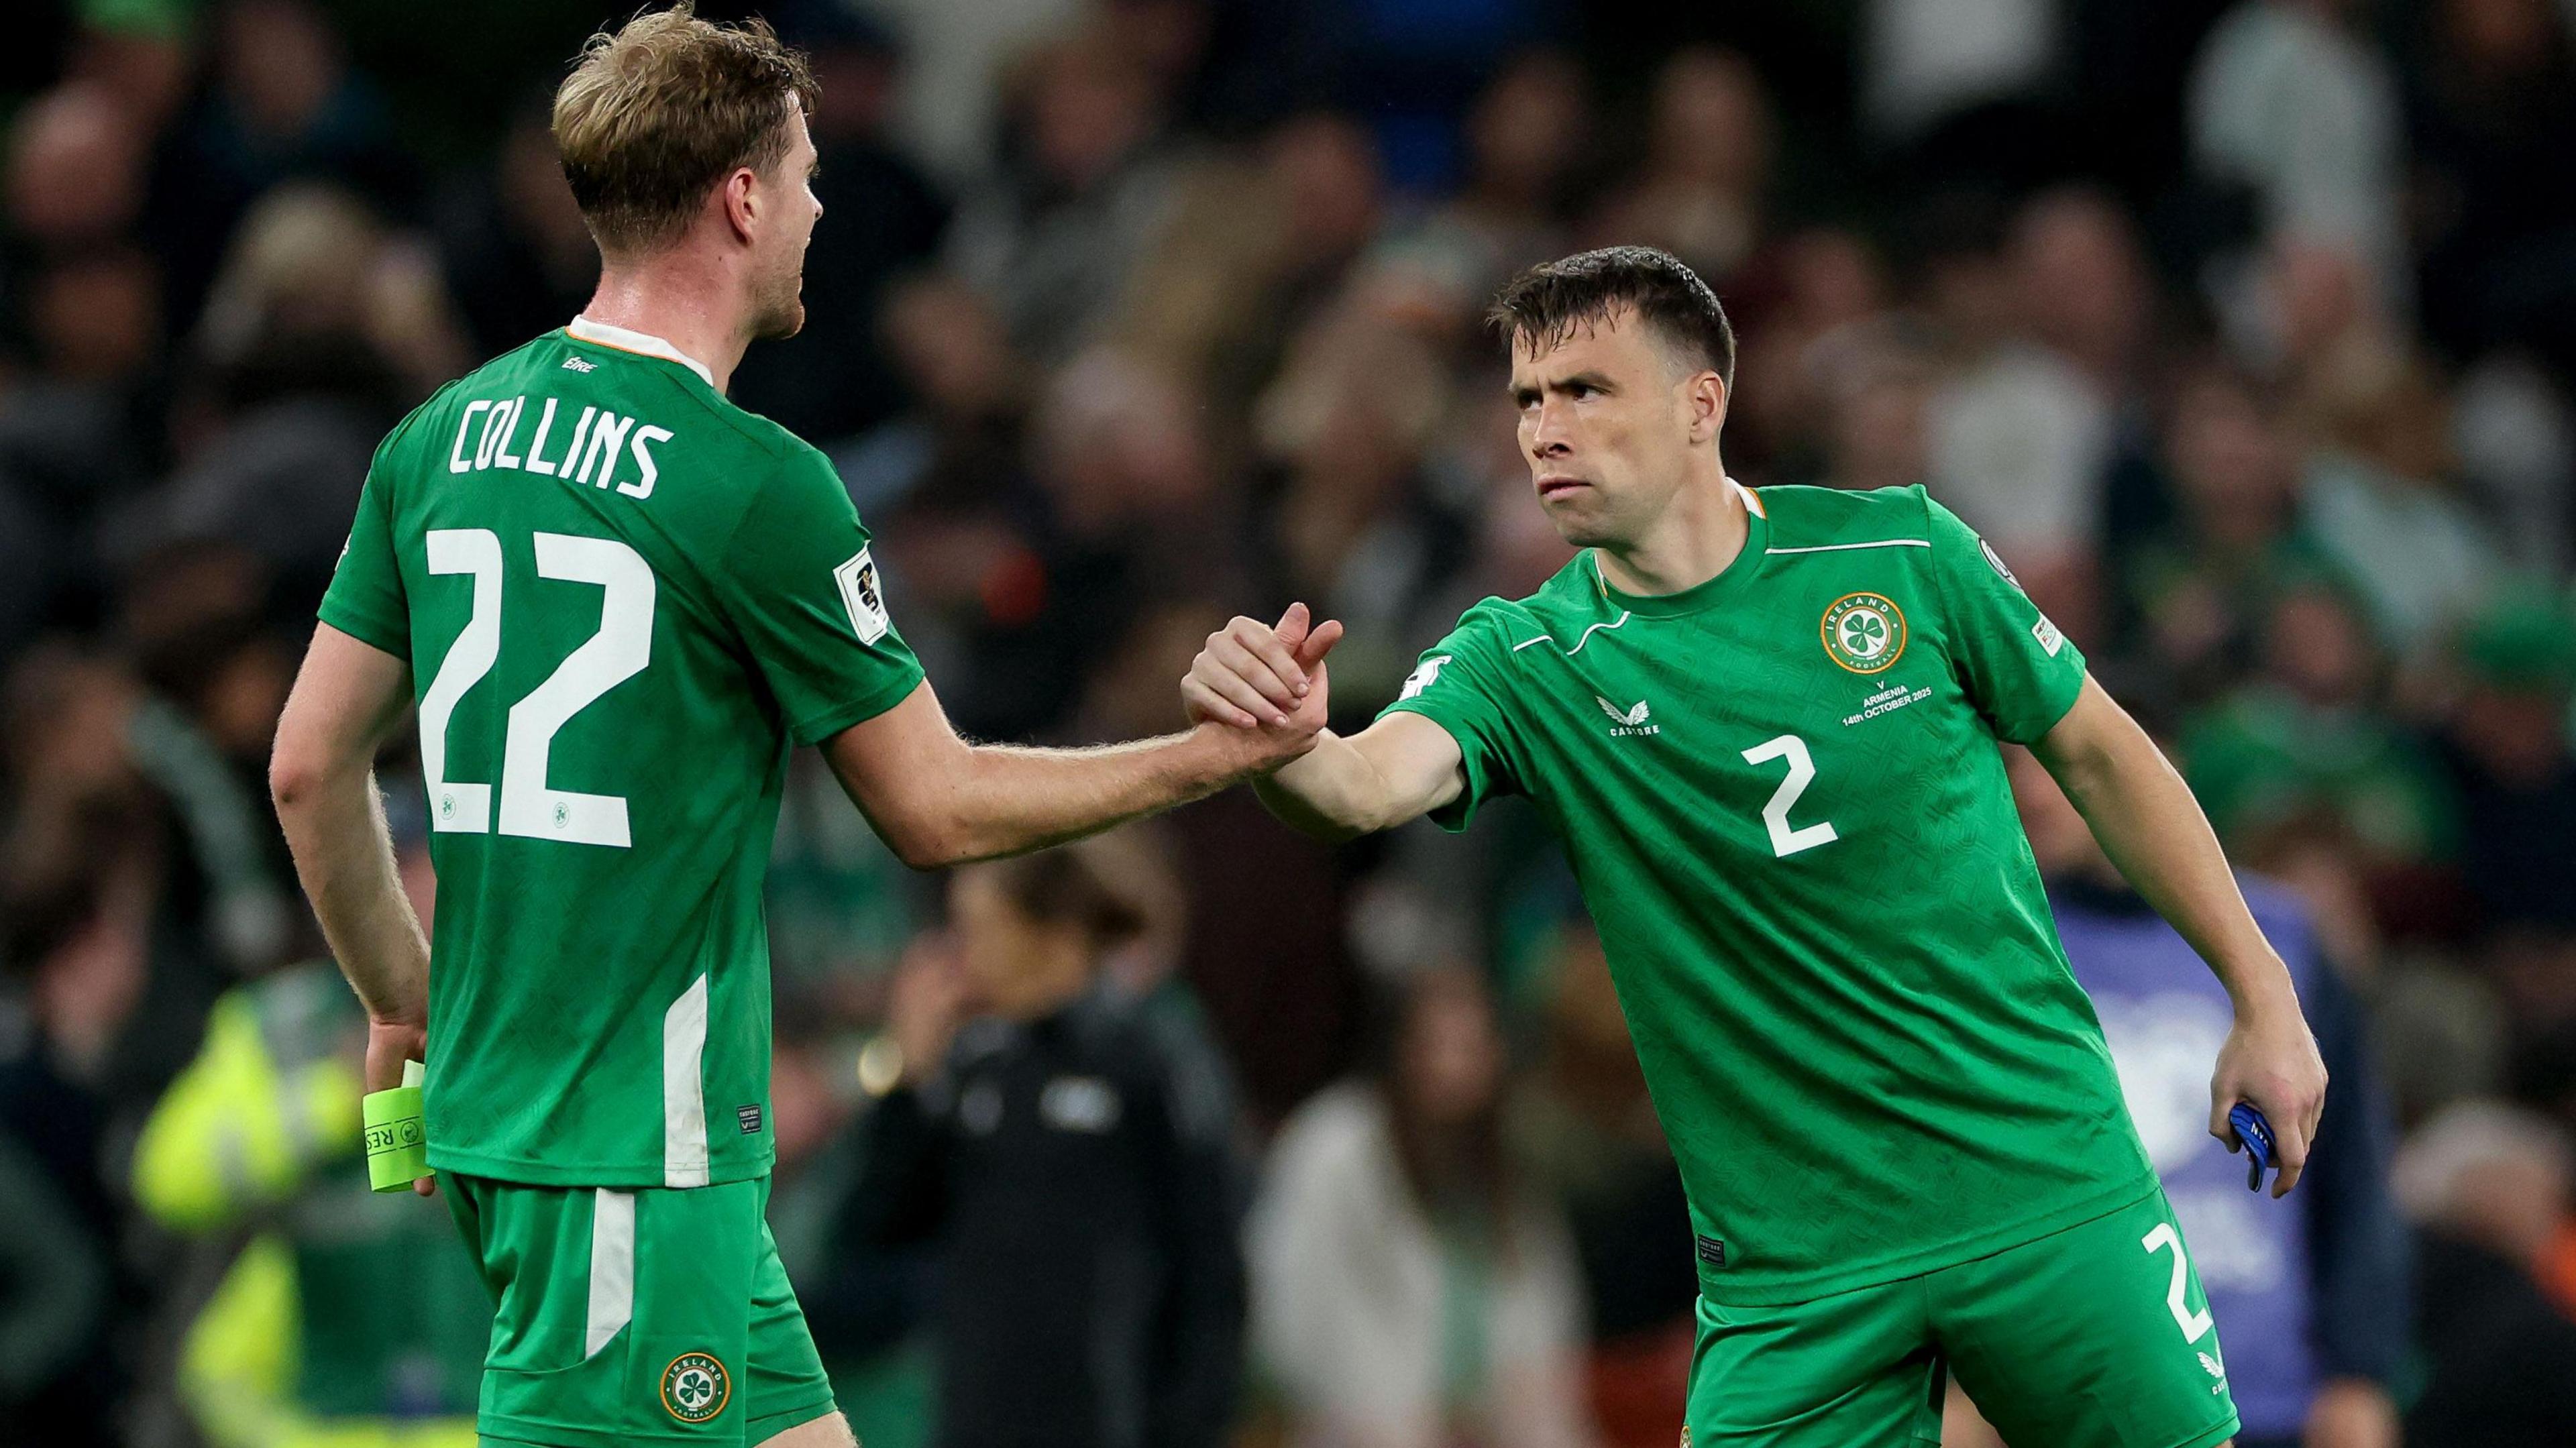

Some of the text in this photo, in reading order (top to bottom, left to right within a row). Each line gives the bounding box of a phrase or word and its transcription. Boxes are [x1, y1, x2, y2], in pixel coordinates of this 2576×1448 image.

[561, 356, 598, 373] ÉIRE
[449, 395, 675, 500] COLLINS
[1825, 597, 1889, 630] IRELAND
[1849, 647, 1896, 669] FOOTBALL
[419, 528, 656, 848] 22
[1863, 685, 1909, 708] ARMENIA
[1842, 687, 1932, 726] 14th OCTOBER 2025
[1610, 724, 1660, 736] CASTORE
[1740, 734, 1839, 858] 2
[2141, 1222, 2214, 1345] 2
[669, 1359, 722, 1380] IRELAND
